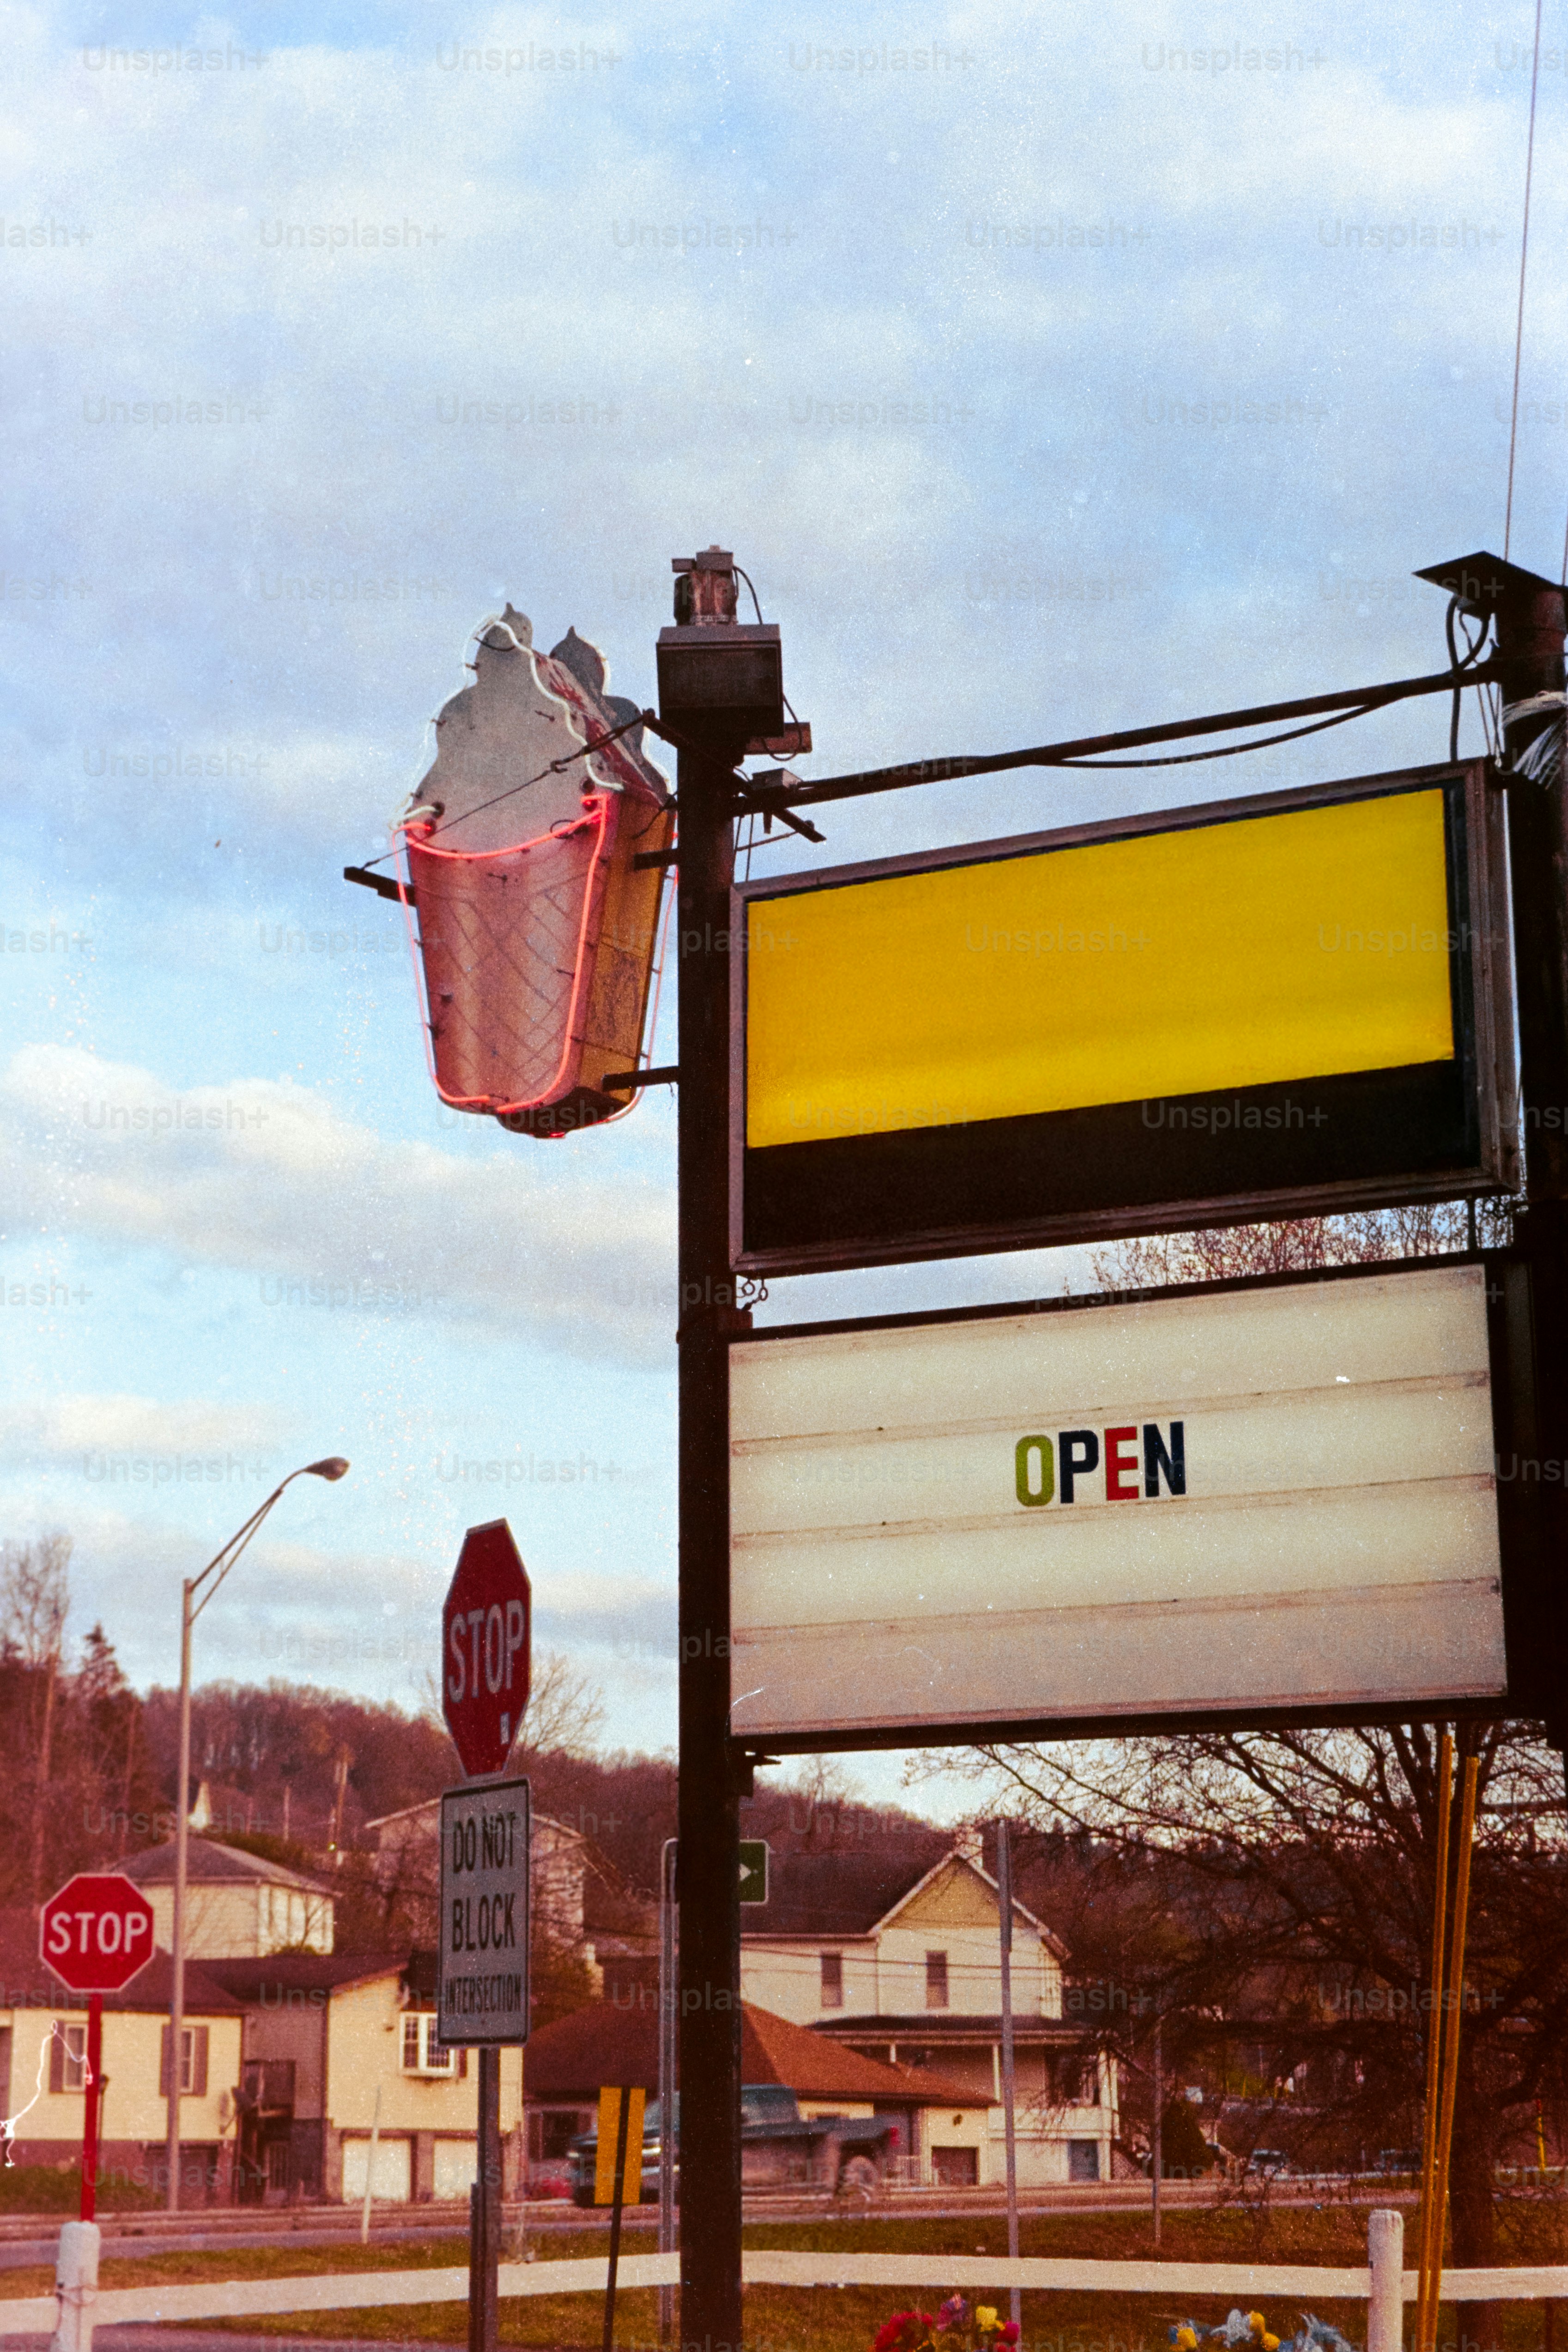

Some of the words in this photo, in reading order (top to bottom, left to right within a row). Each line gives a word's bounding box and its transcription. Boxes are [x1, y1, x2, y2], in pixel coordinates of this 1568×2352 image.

[1015, 1421, 1187, 1507] OPEN
[447, 1599, 526, 1703] STOP
[453, 1817, 476, 1874] DO
[482, 1811, 516, 1870] NOT
[48, 1911, 148, 1955] STOP
[452, 1893, 516, 1953] BLOCK
[445, 1974, 521, 2015] INTERSECTION
